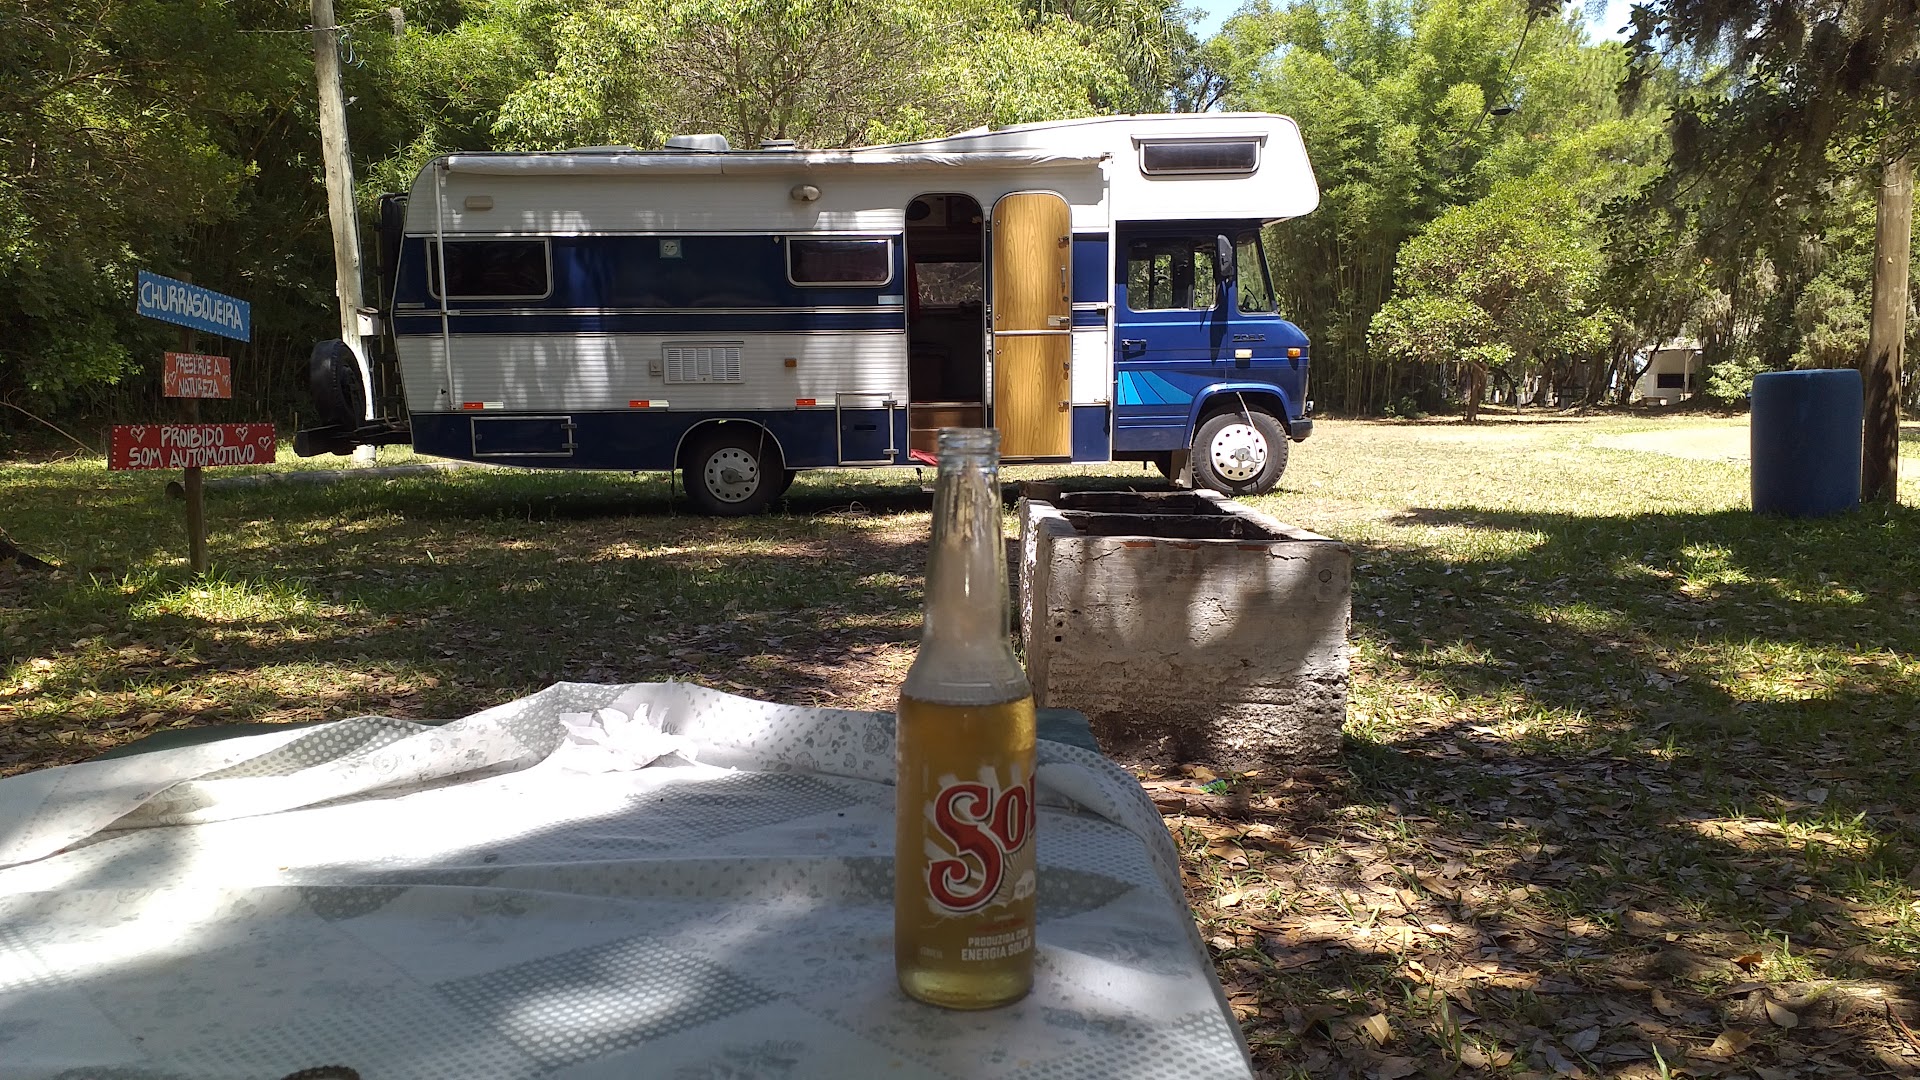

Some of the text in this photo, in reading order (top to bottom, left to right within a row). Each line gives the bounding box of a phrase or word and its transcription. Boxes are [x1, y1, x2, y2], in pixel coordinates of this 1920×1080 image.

[140, 281, 243, 331] CHURRASQUEIRA
[175, 355, 221, 376] PRESERVE A
[178, 377, 220, 398] NATUREZA
[160, 427, 224, 448] PROIBIDO
[128, 444, 255, 468] SOM AUTOMOTIVO
[961, 946, 1007, 961] ENERGIA
